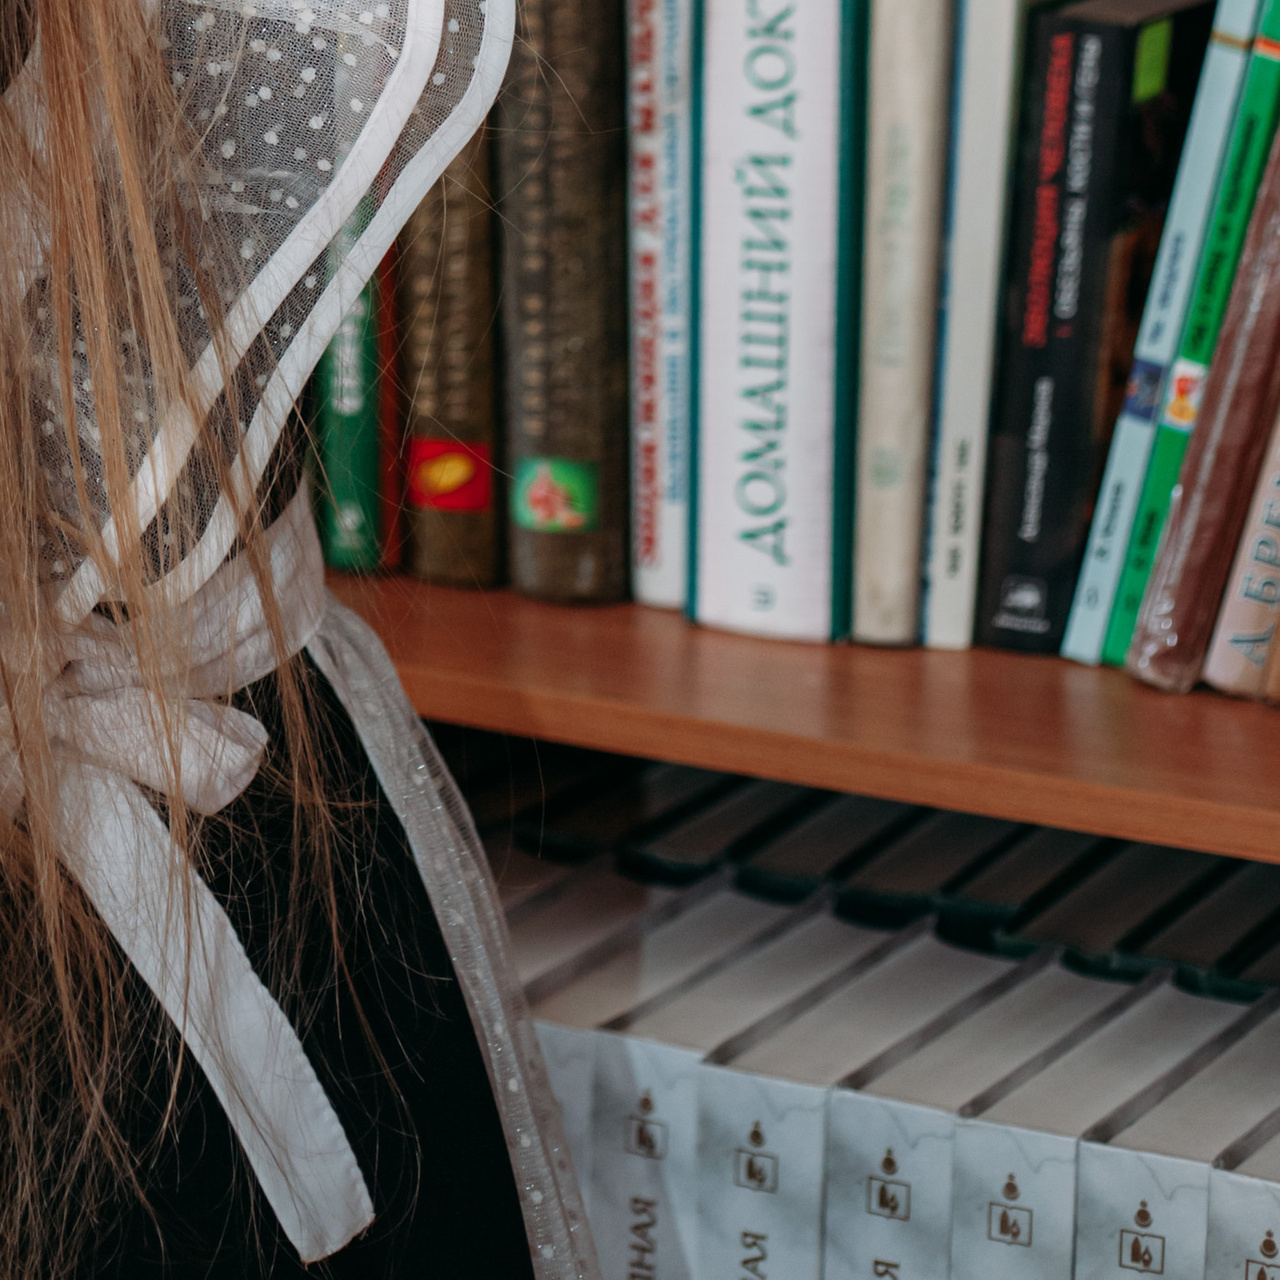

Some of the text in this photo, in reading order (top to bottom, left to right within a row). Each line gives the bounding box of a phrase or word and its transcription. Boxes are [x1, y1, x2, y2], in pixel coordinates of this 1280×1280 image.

[732, 152, 790, 568] ДОМАШНИЙ
[1021, 31, 1074, 348] ЭВОЛЮЦИЯ ЧЕЛОВЕКА
